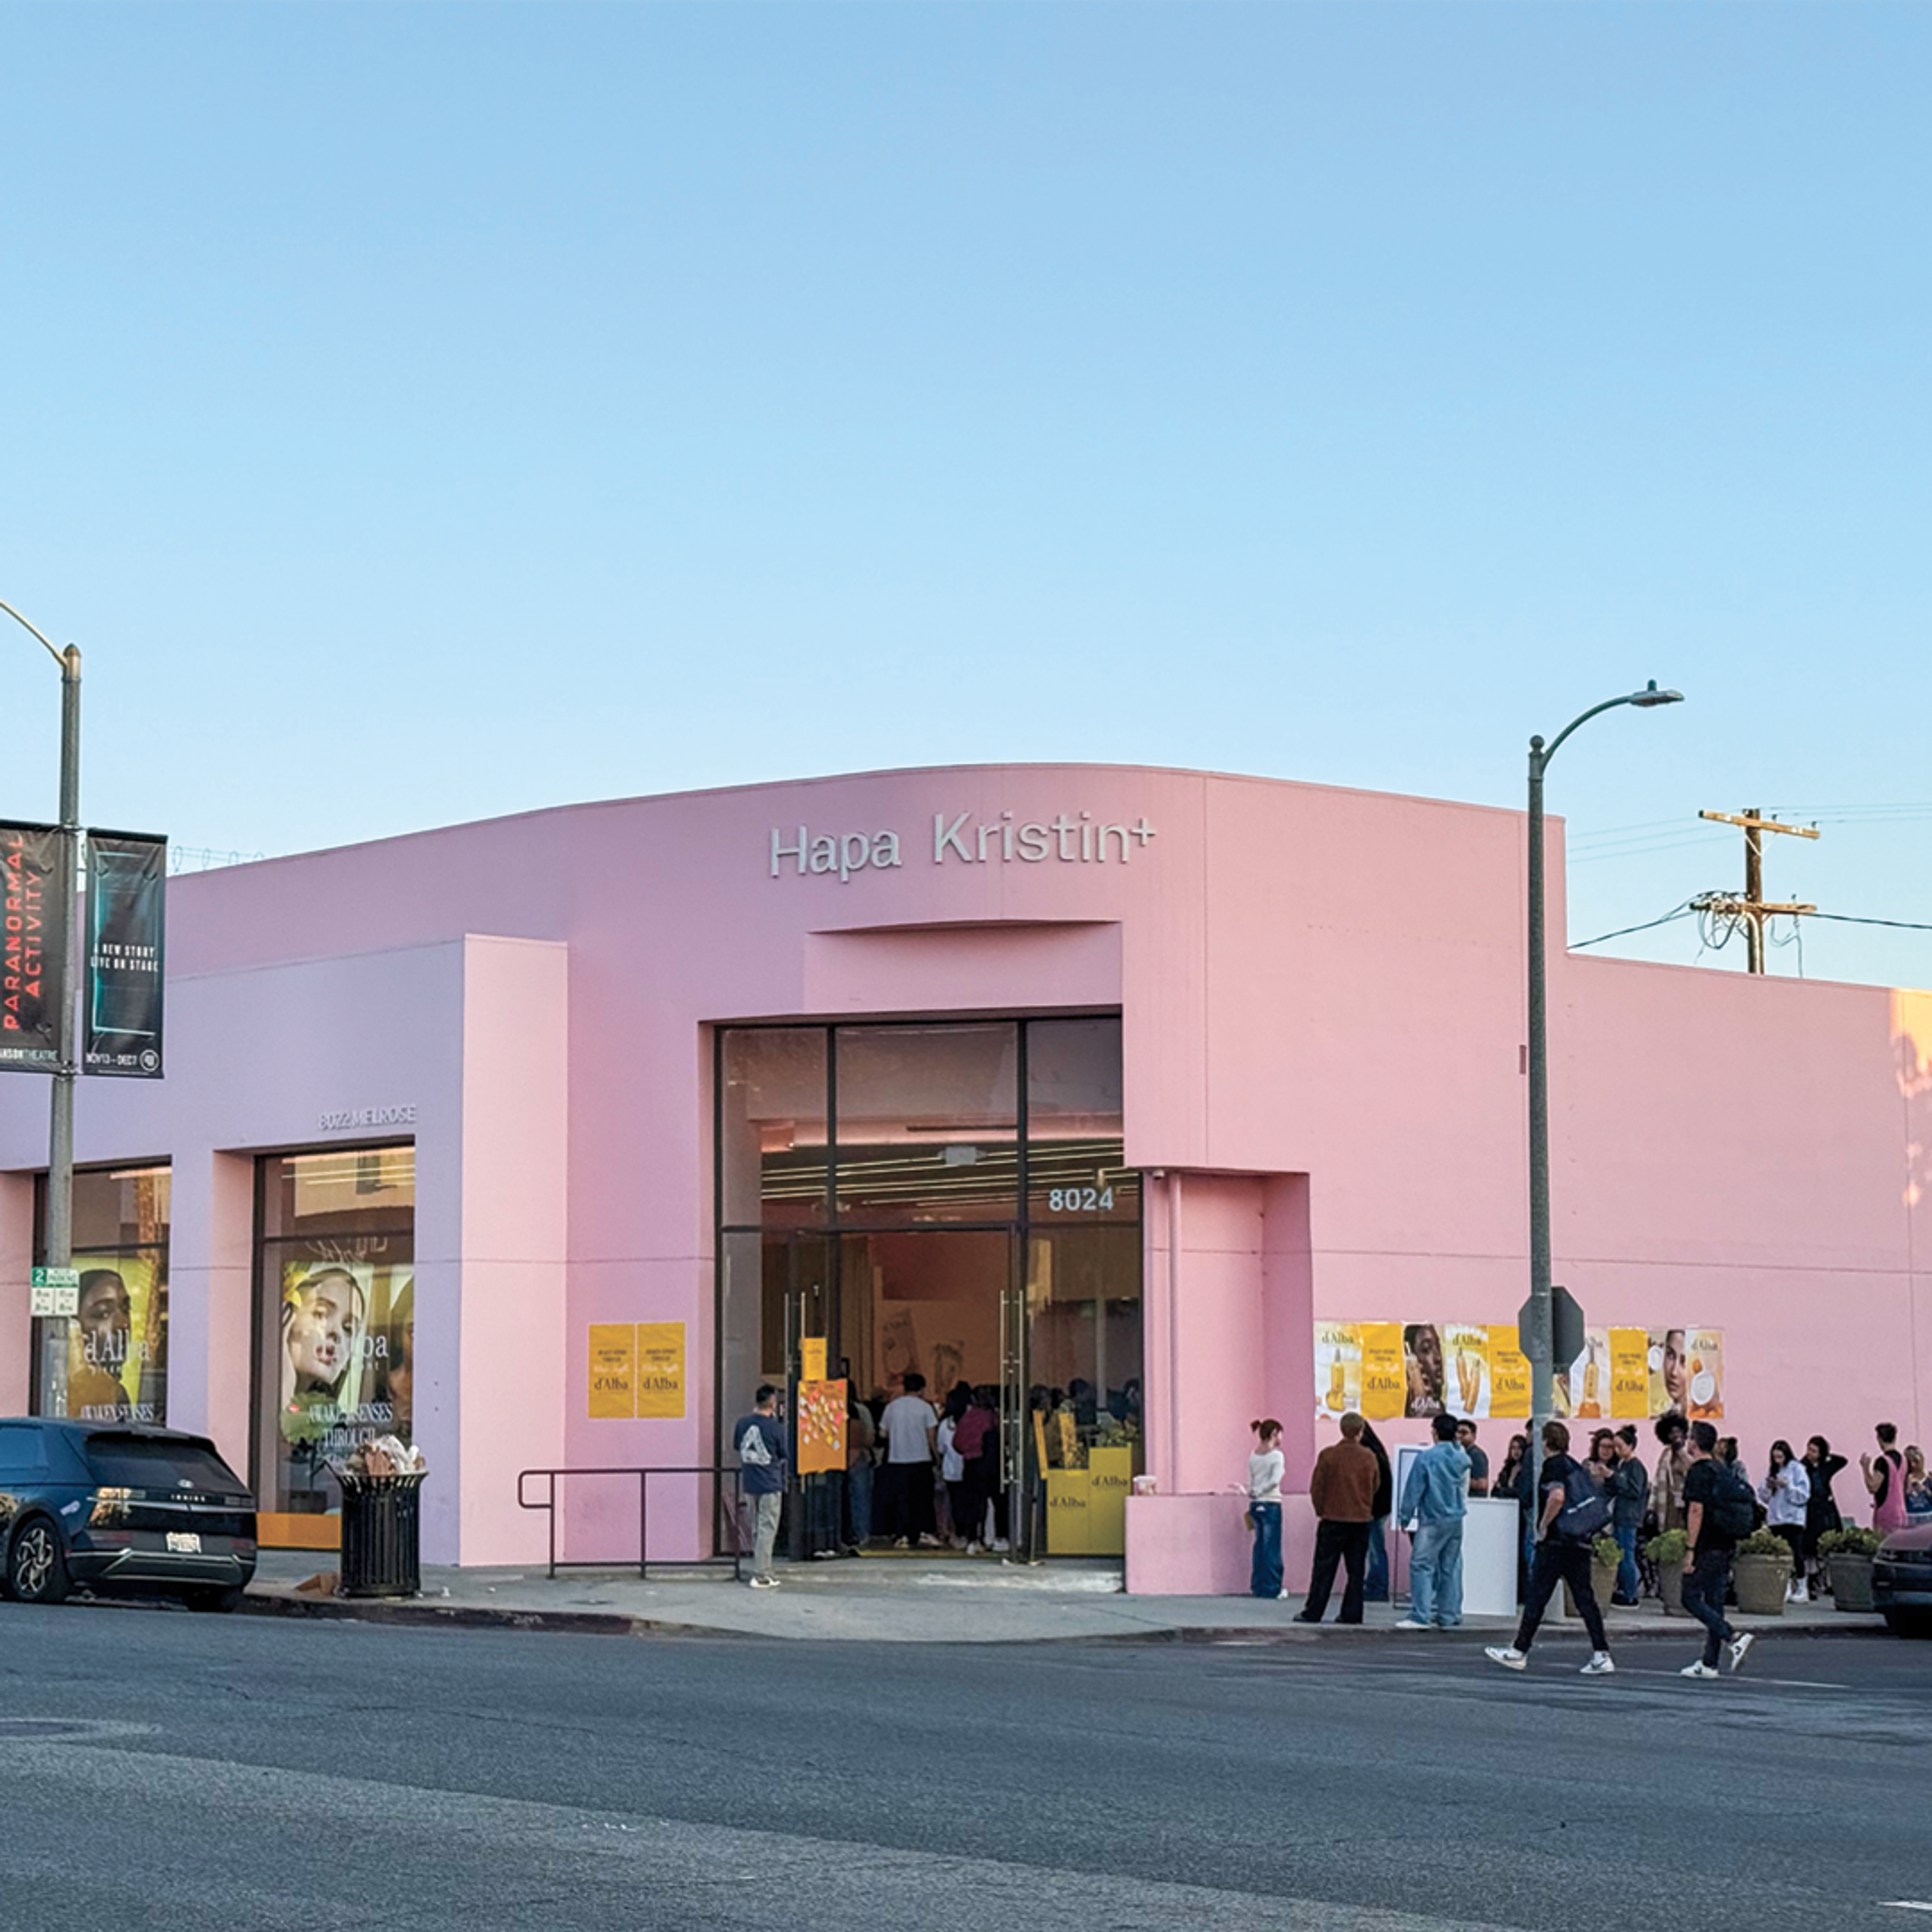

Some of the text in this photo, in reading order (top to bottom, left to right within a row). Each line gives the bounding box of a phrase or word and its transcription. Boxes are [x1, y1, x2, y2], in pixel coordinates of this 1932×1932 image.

[770, 825, 902, 883] Hapa
[3, 834, 24, 1030] PARANORMAL
[25, 871, 42, 998] ACTIVITY
[94, 942, 155, 958] A NEW STORY
[114, 958, 125, 970] ON
[130, 959, 158, 973] STAGE
[353, 1104, 416, 1127] MELROSE
[1050, 1187, 1113, 1212] 8024
[36, 1269, 44, 1282] 2
[1366, 1376, 1400, 1390] d'Alba
